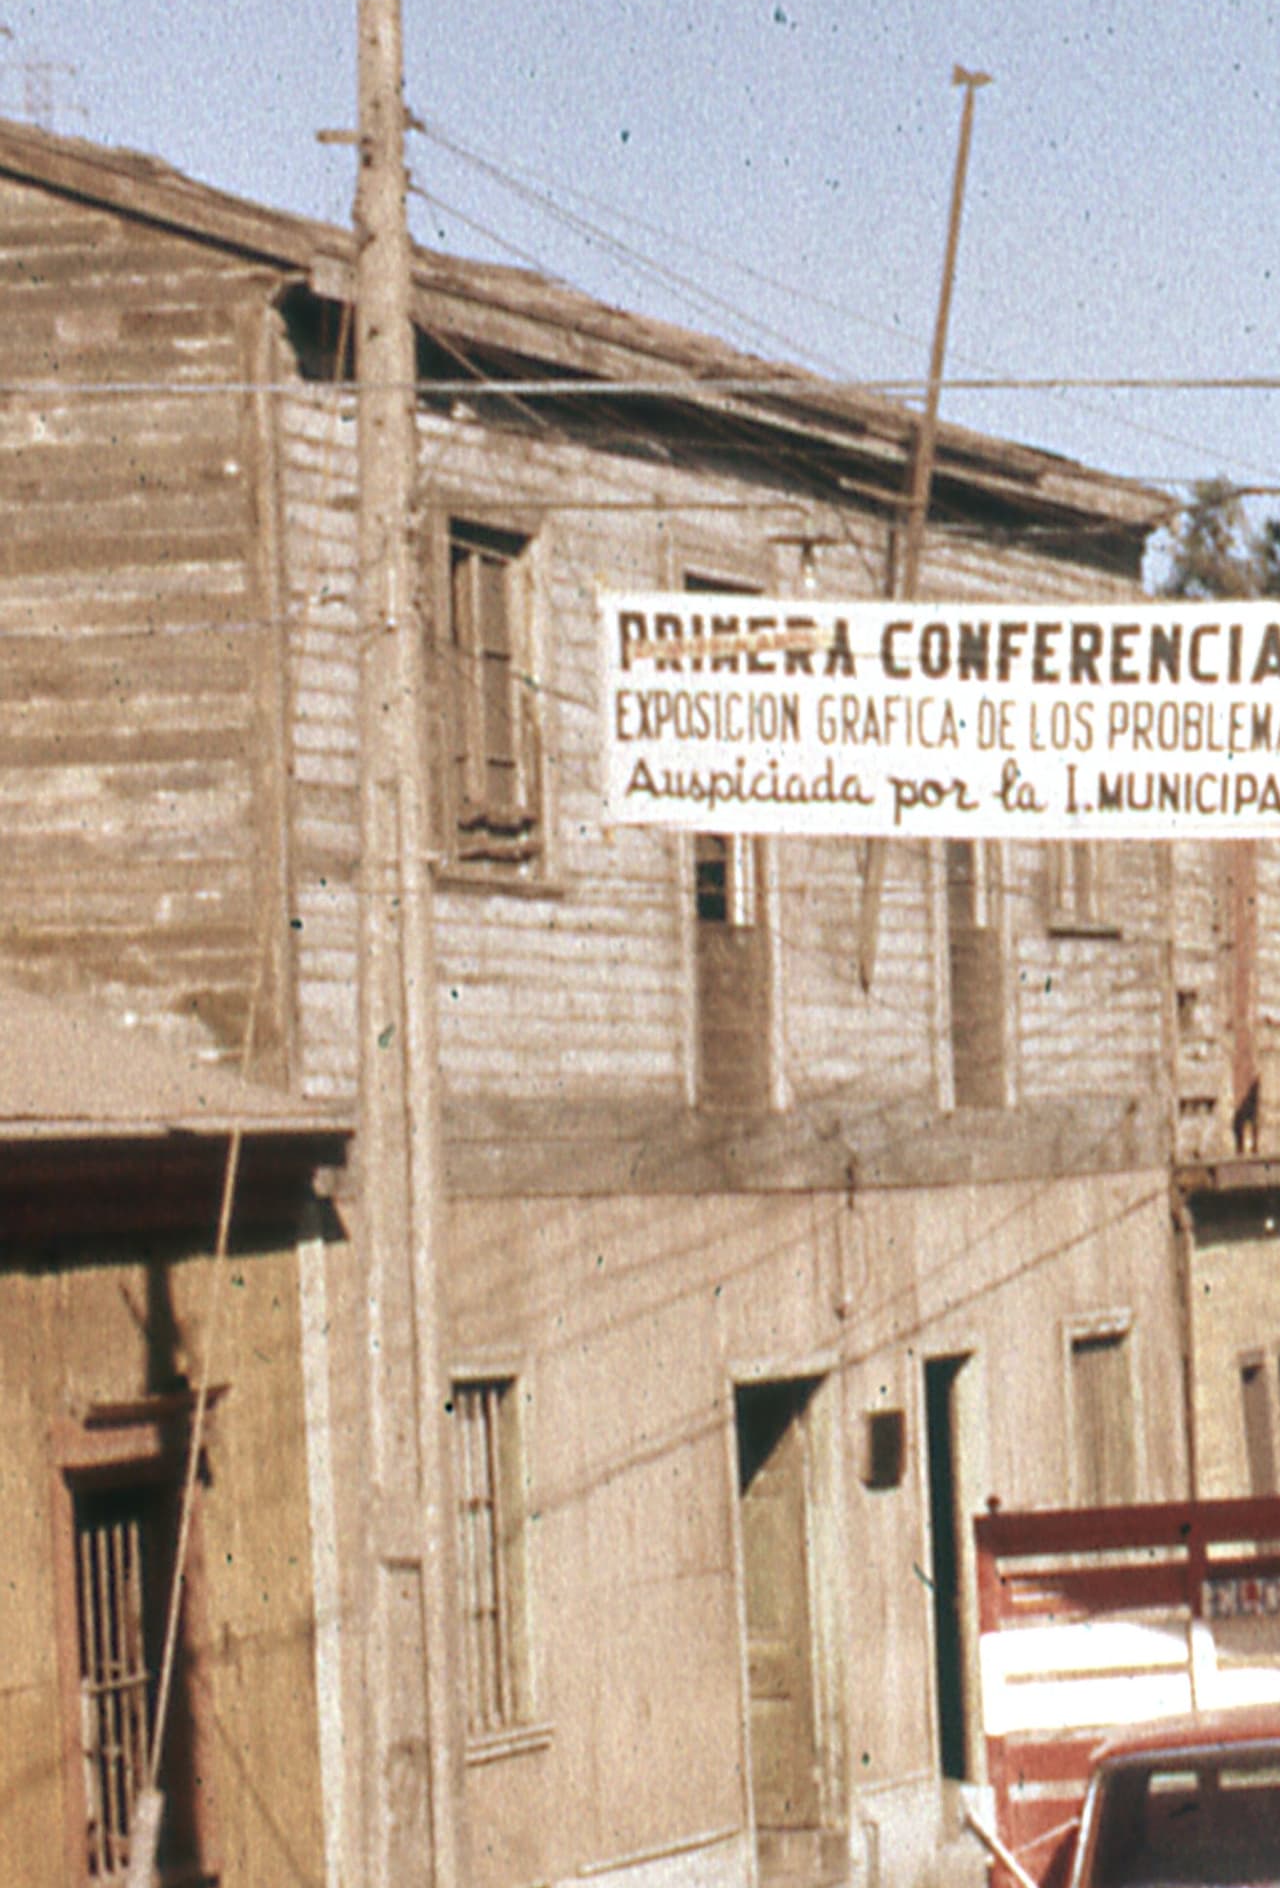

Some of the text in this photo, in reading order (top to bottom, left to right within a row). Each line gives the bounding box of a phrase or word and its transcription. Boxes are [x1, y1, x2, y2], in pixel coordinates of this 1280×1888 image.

[618, 609, 857, 677] PRIMERA
[615, 688, 801, 744] EXPOSICION
[817, 692, 960, 749] GRAFICA
[977, 699, 1017, 751] DE
[1030, 700, 1094, 753] LOS
[624, 756, 876, 812] Auspiciada
[887, 775, 980, 827] por
[991, 757, 1049, 814] la
